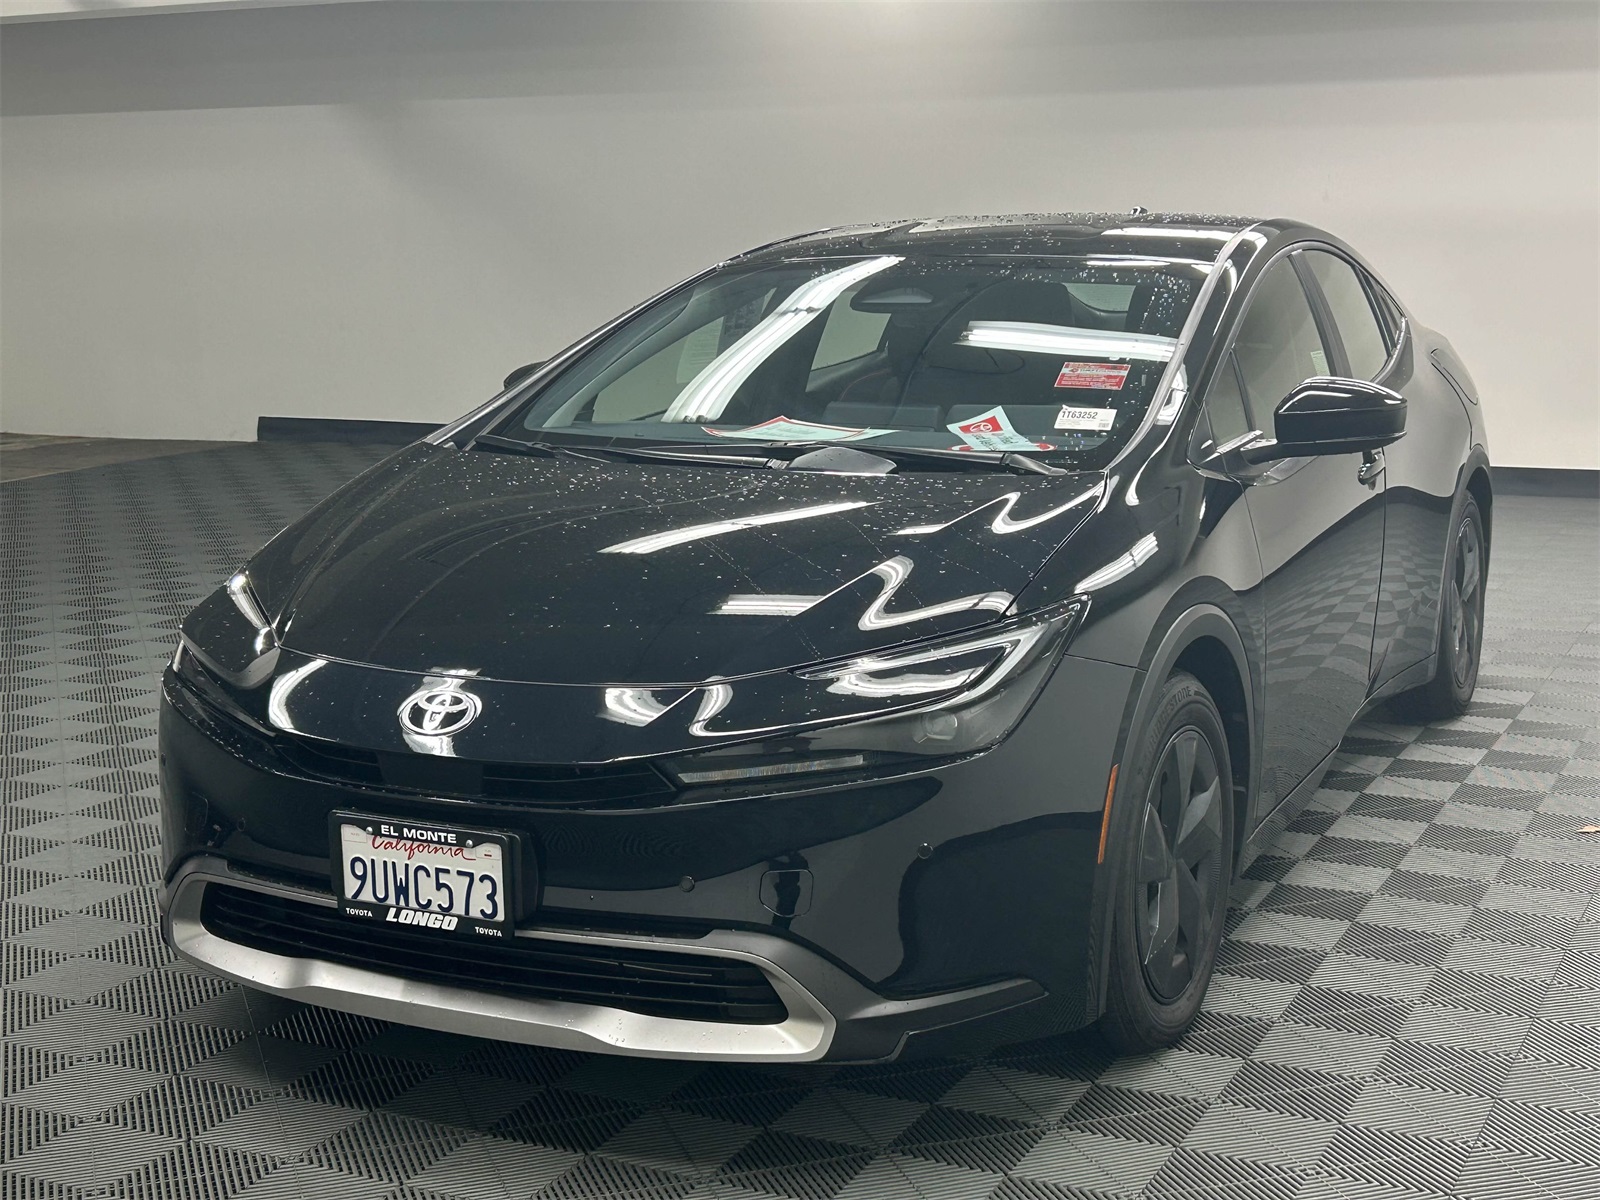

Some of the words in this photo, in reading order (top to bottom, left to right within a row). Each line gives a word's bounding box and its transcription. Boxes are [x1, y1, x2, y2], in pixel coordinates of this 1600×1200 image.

[1062, 411, 1098, 419] 1T63252
[381, 825, 398, 836] EL
[403, 829, 457, 844] MONTE
[372, 835, 476, 860] California
[350, 856, 498, 919] 9UWC573
[346, 907, 373, 918] TOYOTA
[386, 908, 458, 930] LONGO
[475, 926, 502, 938] TOYOTA
